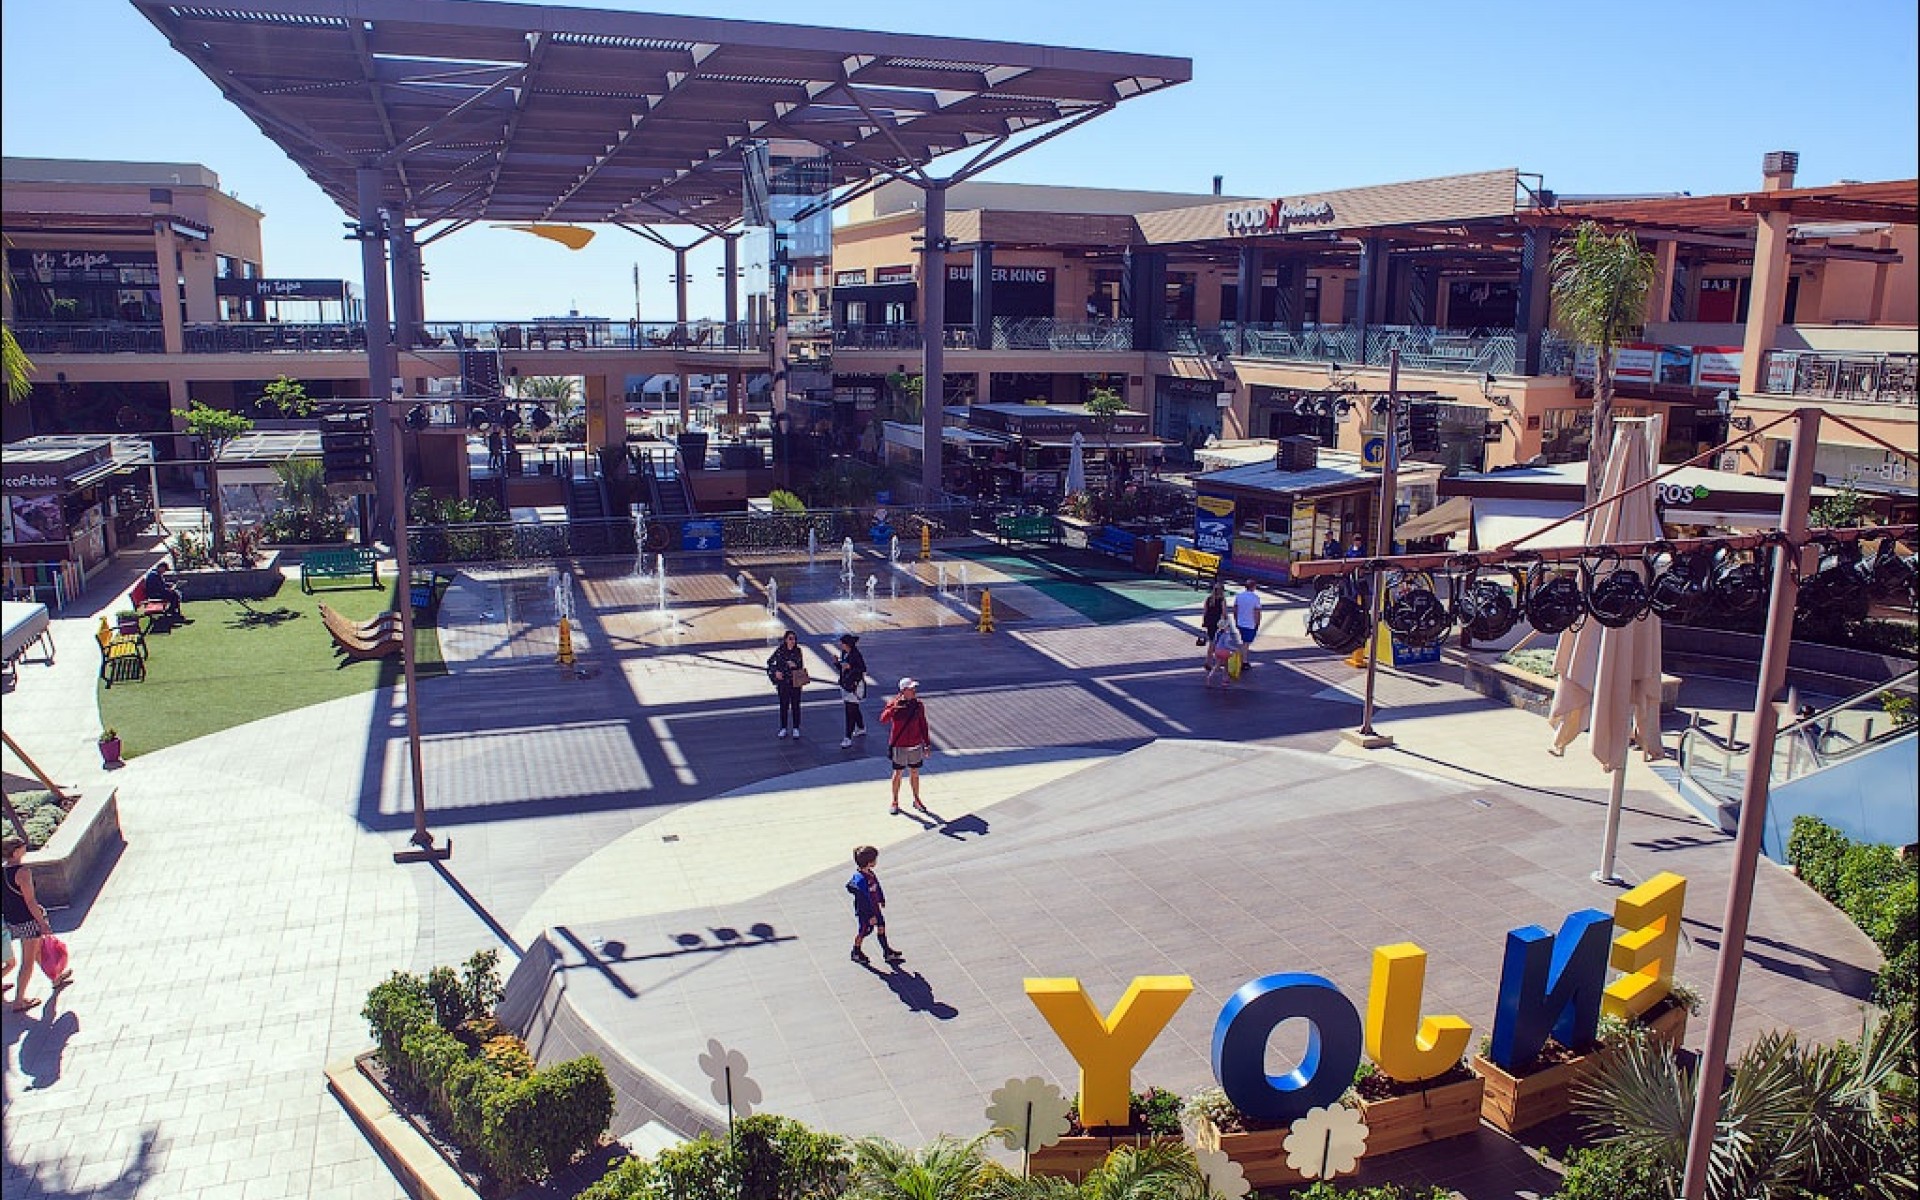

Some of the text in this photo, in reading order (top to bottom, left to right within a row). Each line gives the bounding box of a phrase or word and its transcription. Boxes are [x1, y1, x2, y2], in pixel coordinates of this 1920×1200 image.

[1224, 206, 1266, 230] FOOD
[949, 266, 1047, 284] BUER KING
[1654, 483, 1694, 505] ROS
